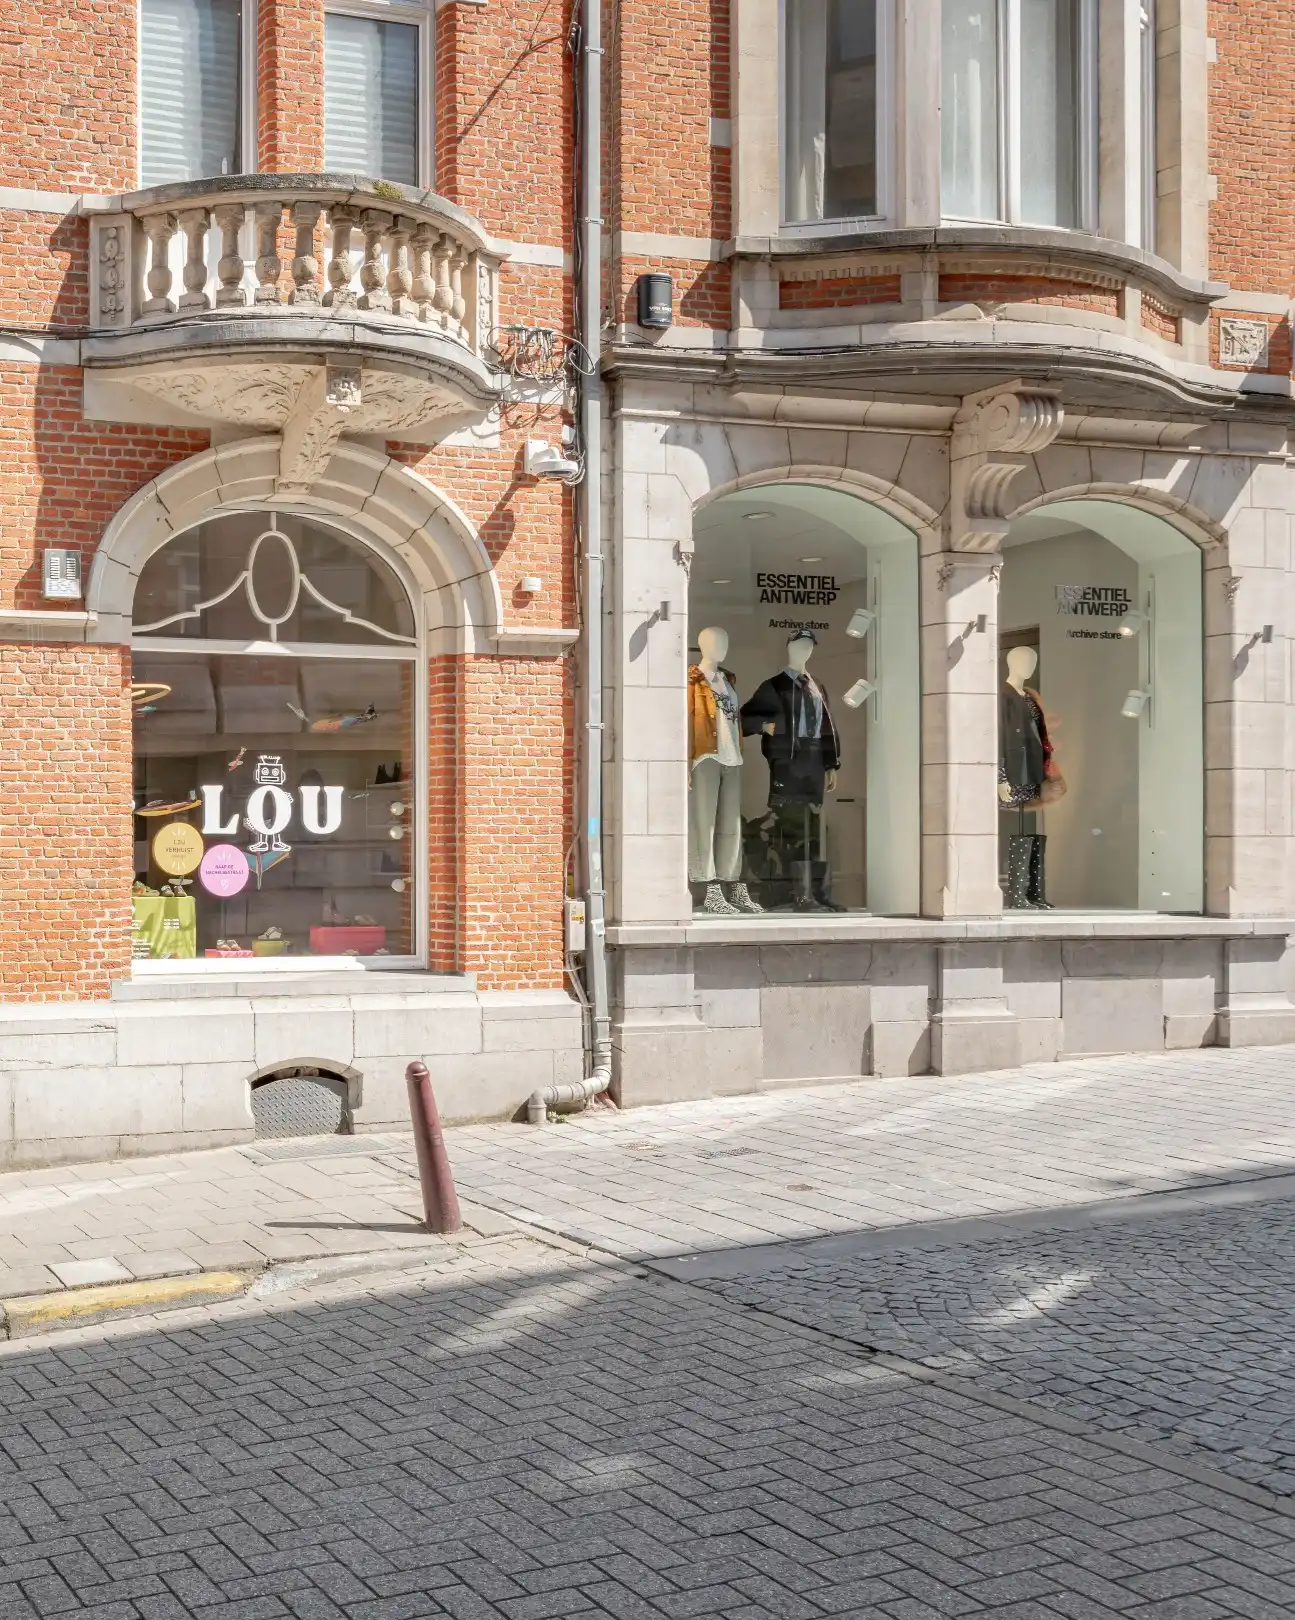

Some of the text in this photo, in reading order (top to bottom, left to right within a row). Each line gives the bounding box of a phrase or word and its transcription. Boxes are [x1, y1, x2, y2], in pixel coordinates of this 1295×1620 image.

[756, 573, 840, 591] ESSENTIEL
[759, 589, 837, 605] ANTWERP
[1057, 600, 1128, 616] ANTWERP
[768, 619, 830, 630] Archive store
[1066, 630, 1122, 639] Archive store
[201, 784, 344, 836] LOU
